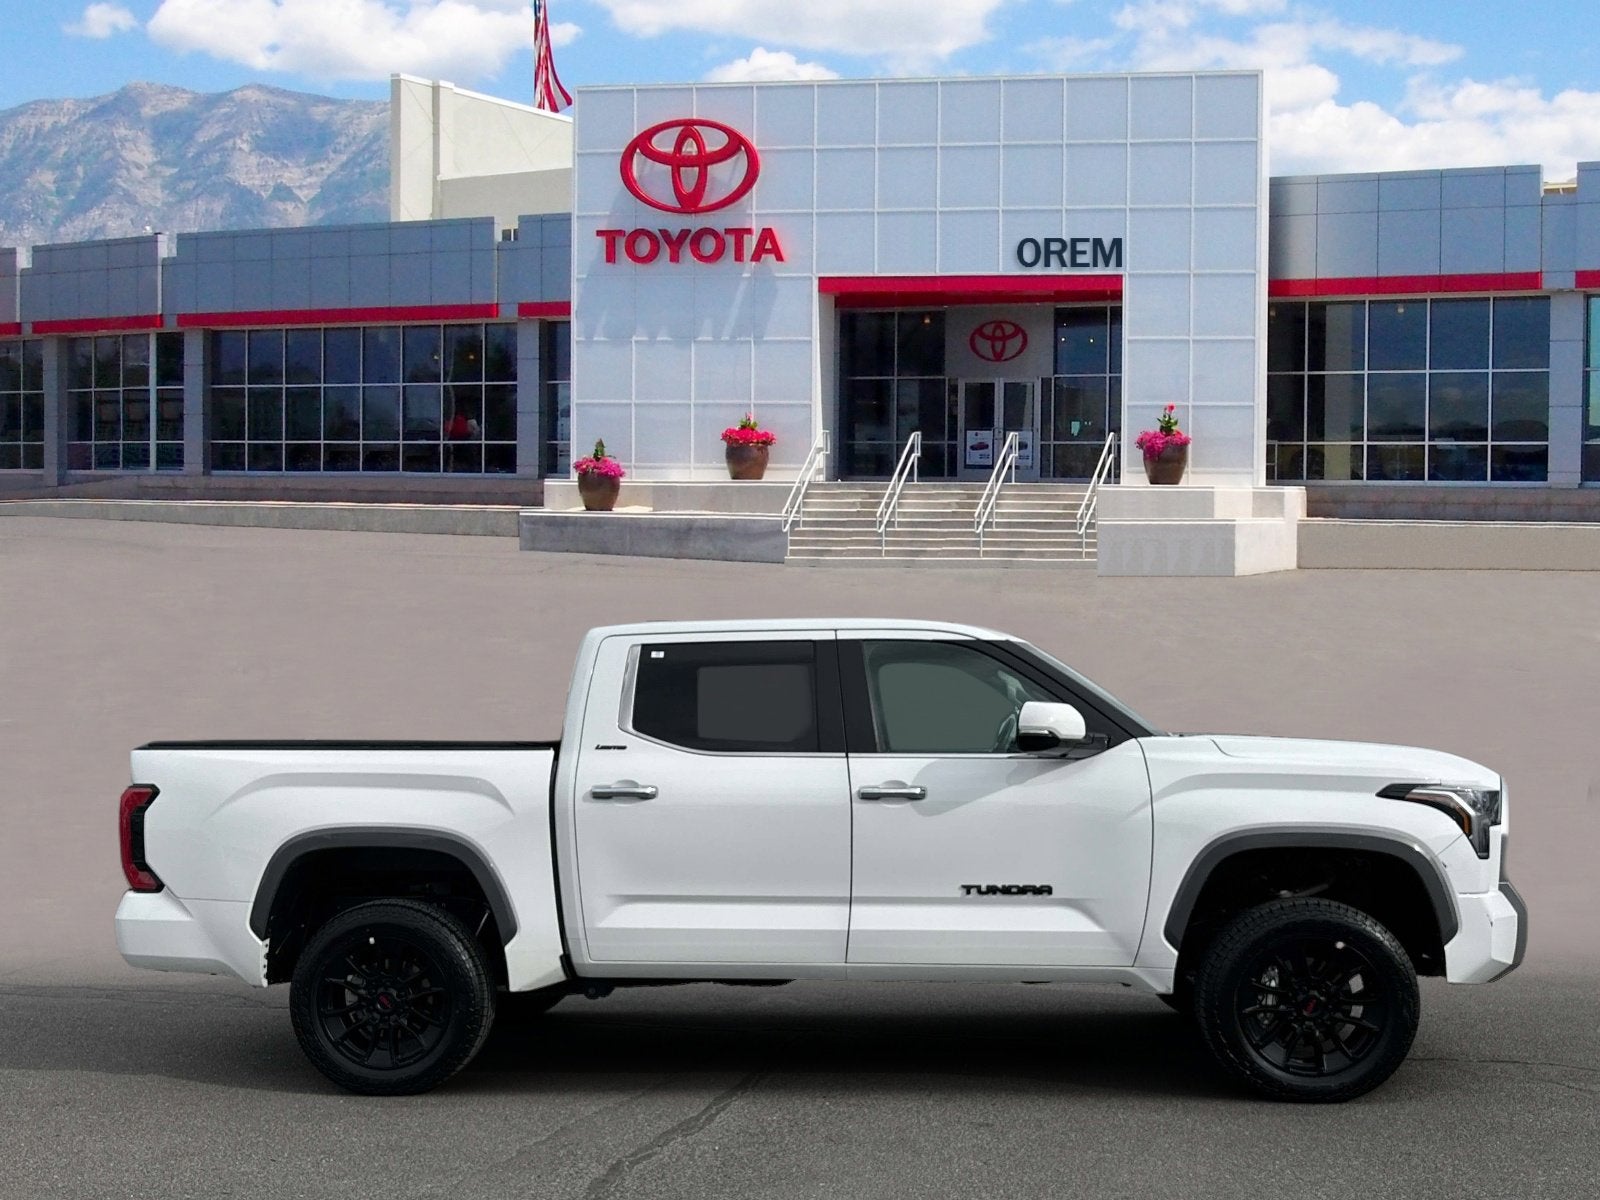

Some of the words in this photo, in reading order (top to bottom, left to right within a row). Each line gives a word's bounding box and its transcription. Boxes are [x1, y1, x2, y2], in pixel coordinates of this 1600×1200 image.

[596, 227, 784, 265] TOYOTA
[1017, 237, 1123, 268] OREM
[961, 884, 1053, 896] TUNDRA
